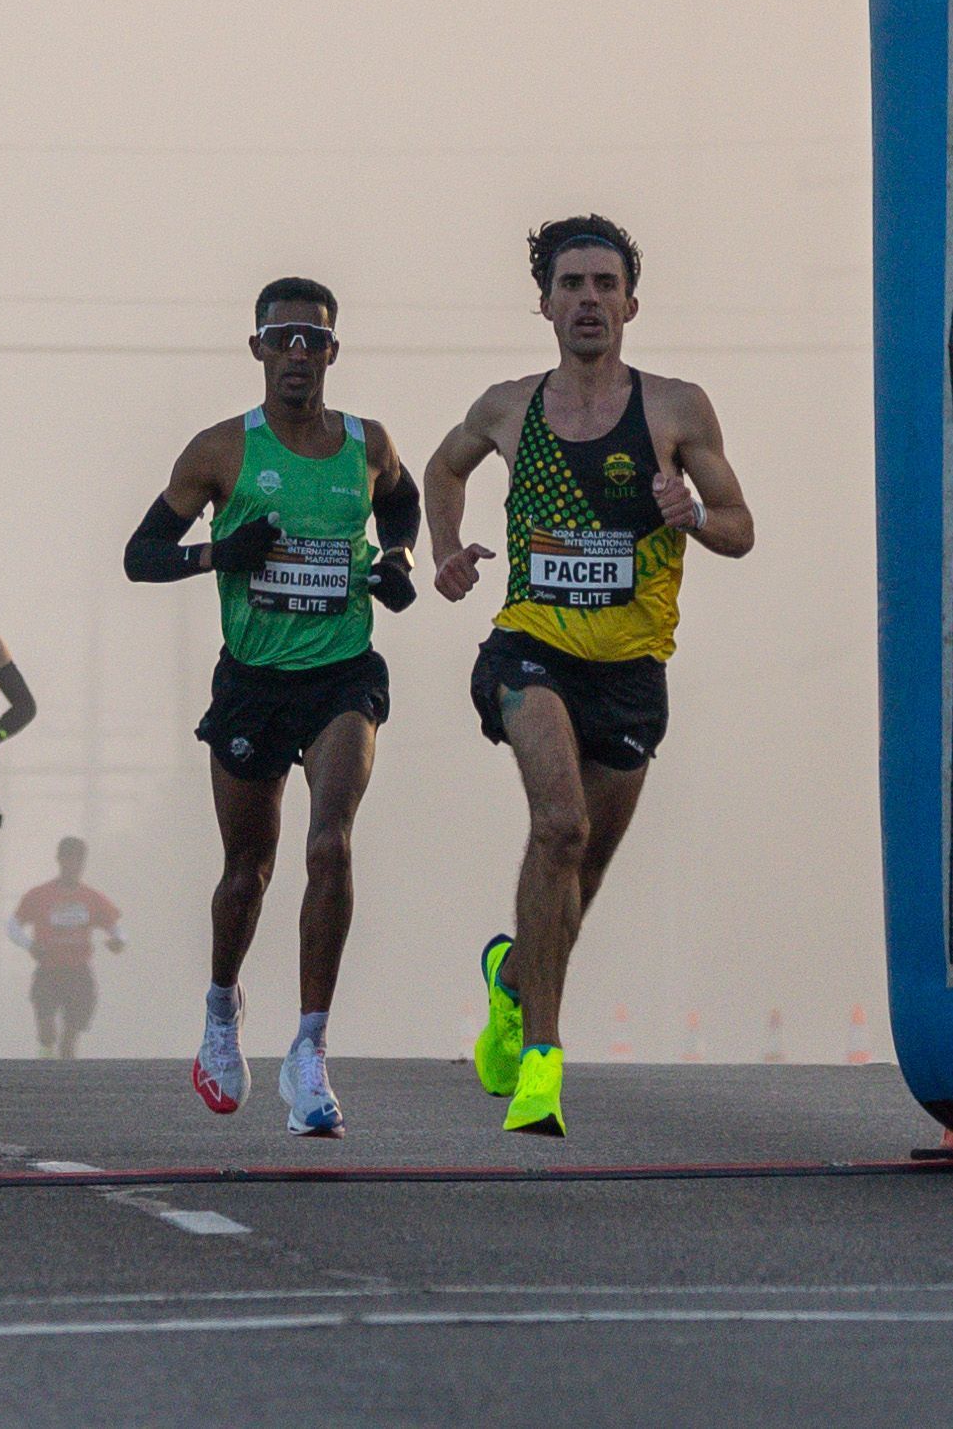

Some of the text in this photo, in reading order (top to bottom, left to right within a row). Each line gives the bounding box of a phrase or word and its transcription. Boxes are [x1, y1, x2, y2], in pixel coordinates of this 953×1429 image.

[552, 528, 575, 538] 2024
[581, 530, 634, 540] CALIFORNIA
[304, 538, 350, 550] CALIFORNIA
[563, 538, 633, 548] INTERNATIONAL
[287, 546, 349, 558] INTERNATIONAL
[583, 547, 633, 556] MARATHON
[304, 556, 350, 565] MARATHON
[544, 560, 618, 584] PACER
[288, 597, 328, 612] ELITE
[569, 592, 612, 605] ELITE
